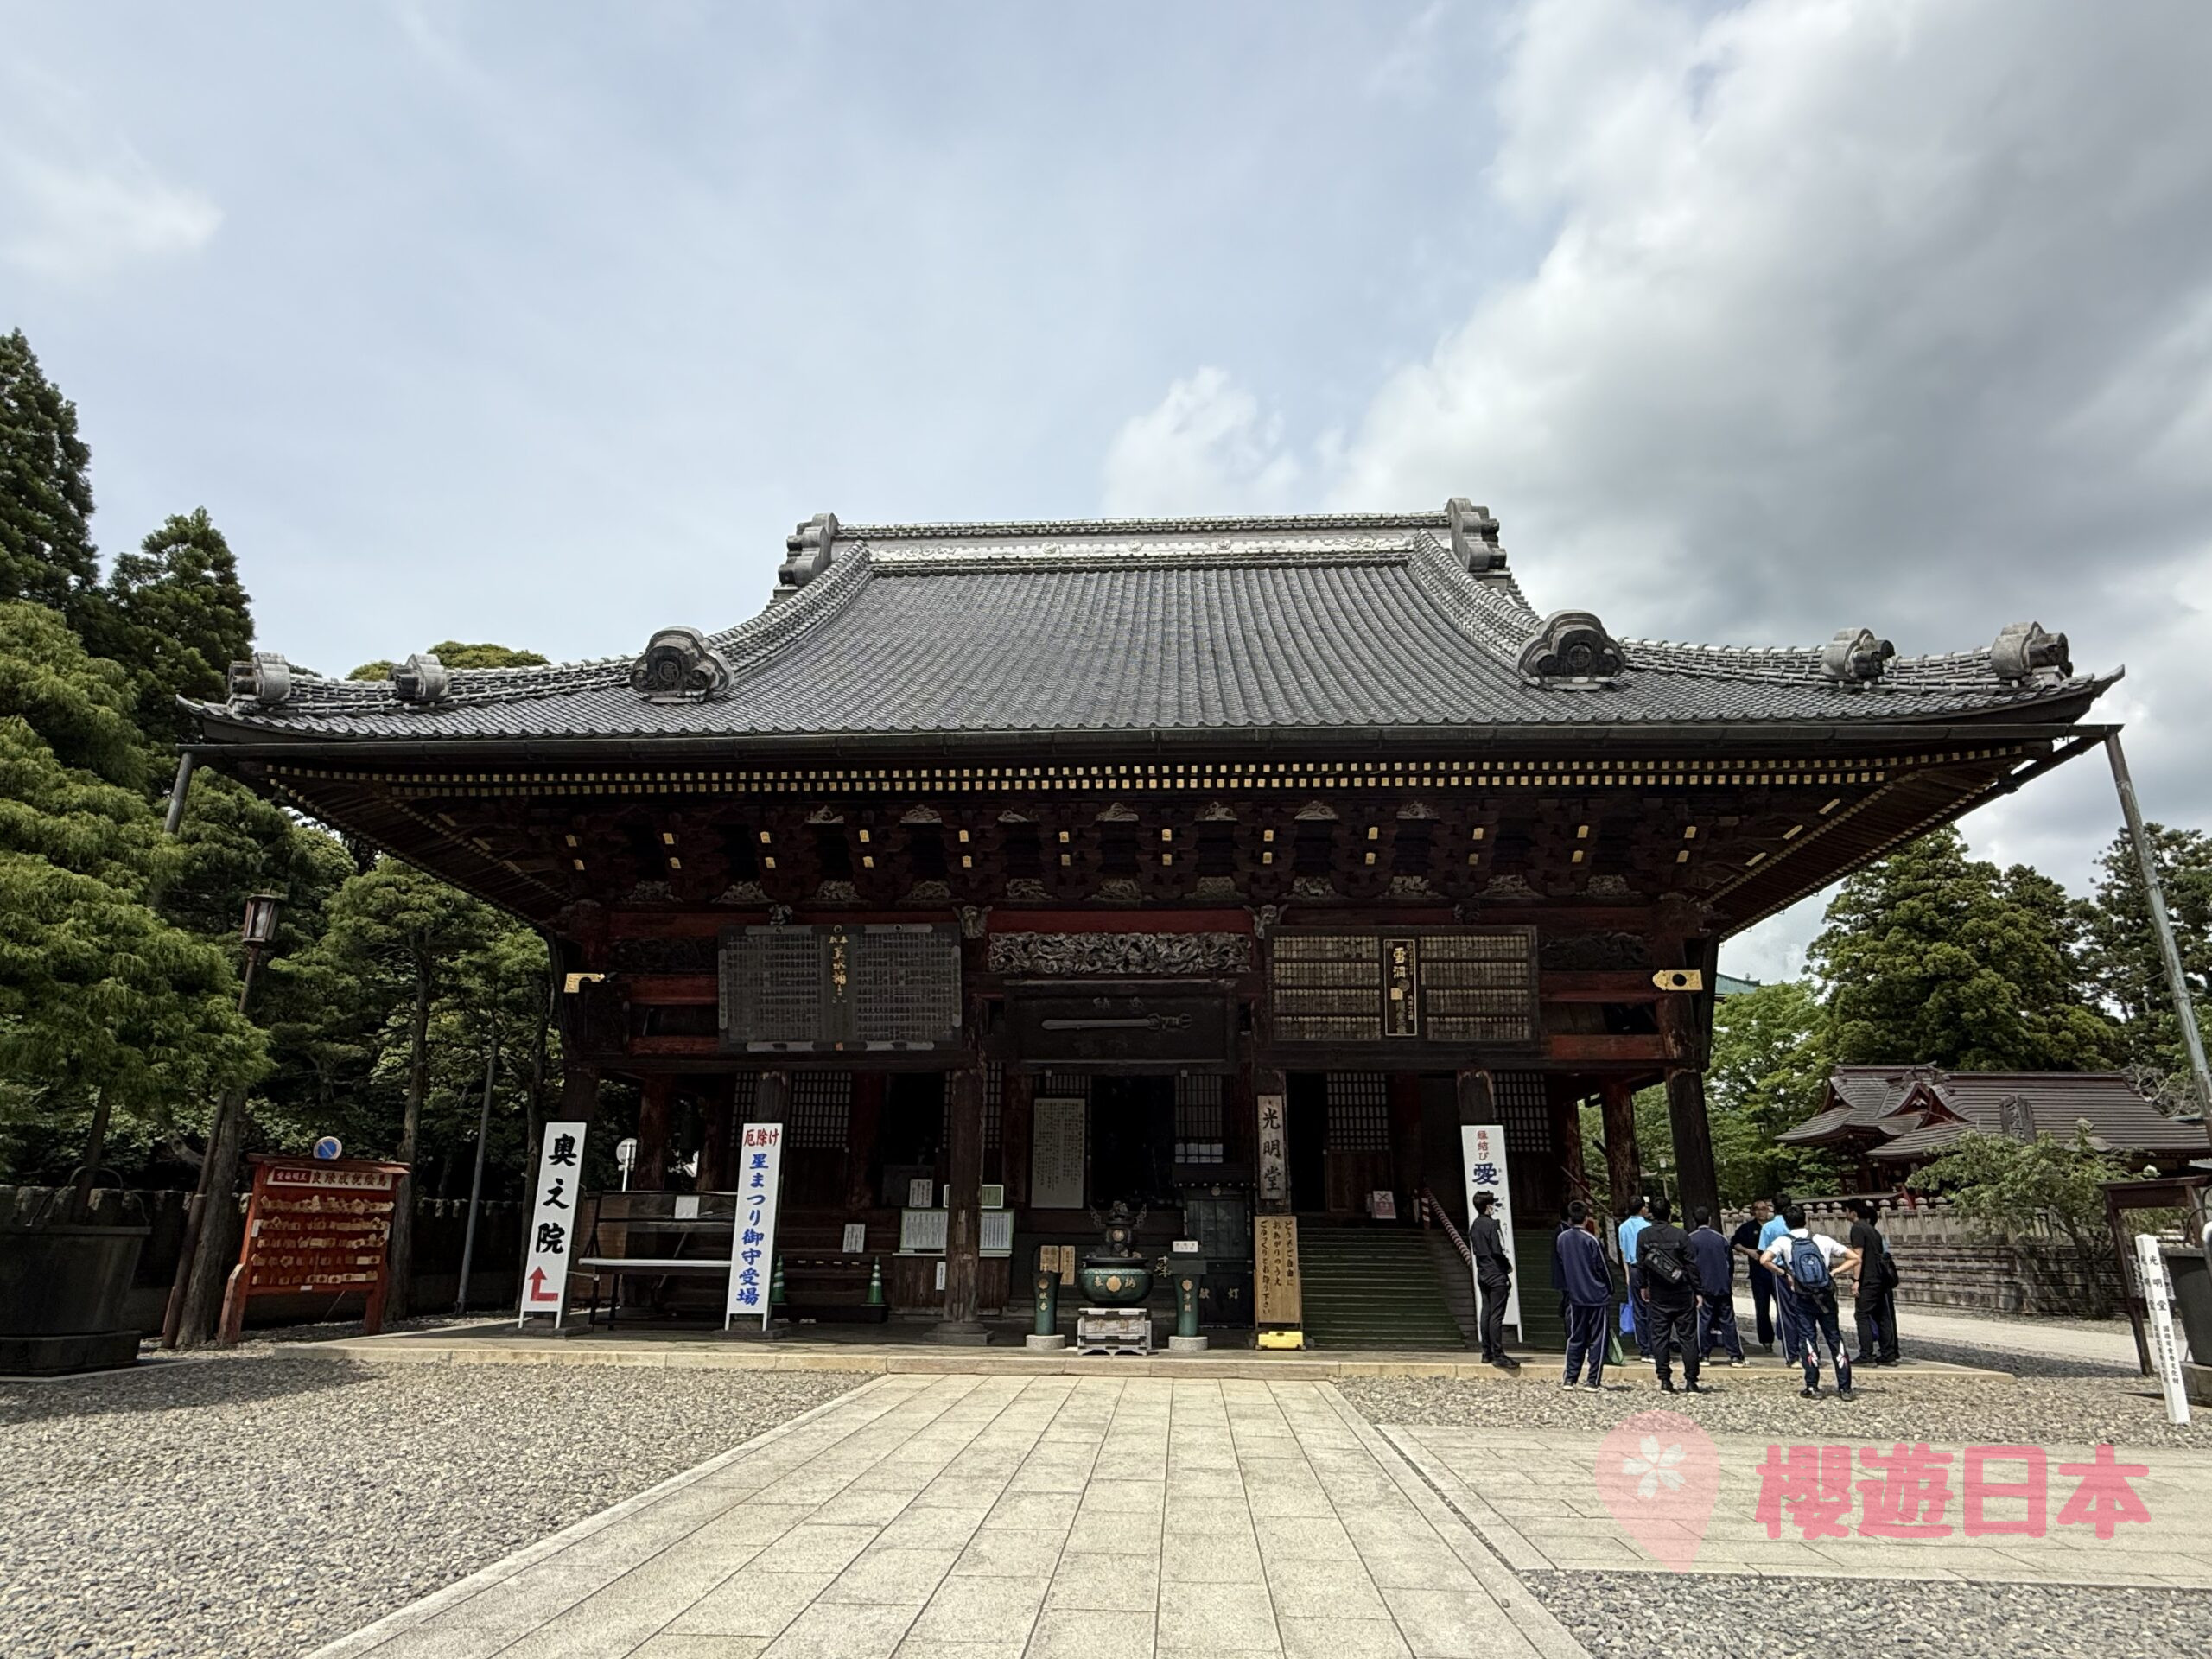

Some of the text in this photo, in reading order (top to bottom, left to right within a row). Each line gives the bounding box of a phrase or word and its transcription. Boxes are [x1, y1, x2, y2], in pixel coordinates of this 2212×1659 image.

[743, 1128, 779, 1147] 厄除け
[1262, 1107, 1281, 1191] 光明堂
[1477, 1130, 1490, 1161] 縁結び
[536, 1133, 577, 1255] 奥之院
[736, 1153, 769, 1306] 星まつり御守受場
[2149, 1255, 2167, 1312] 光明堂
